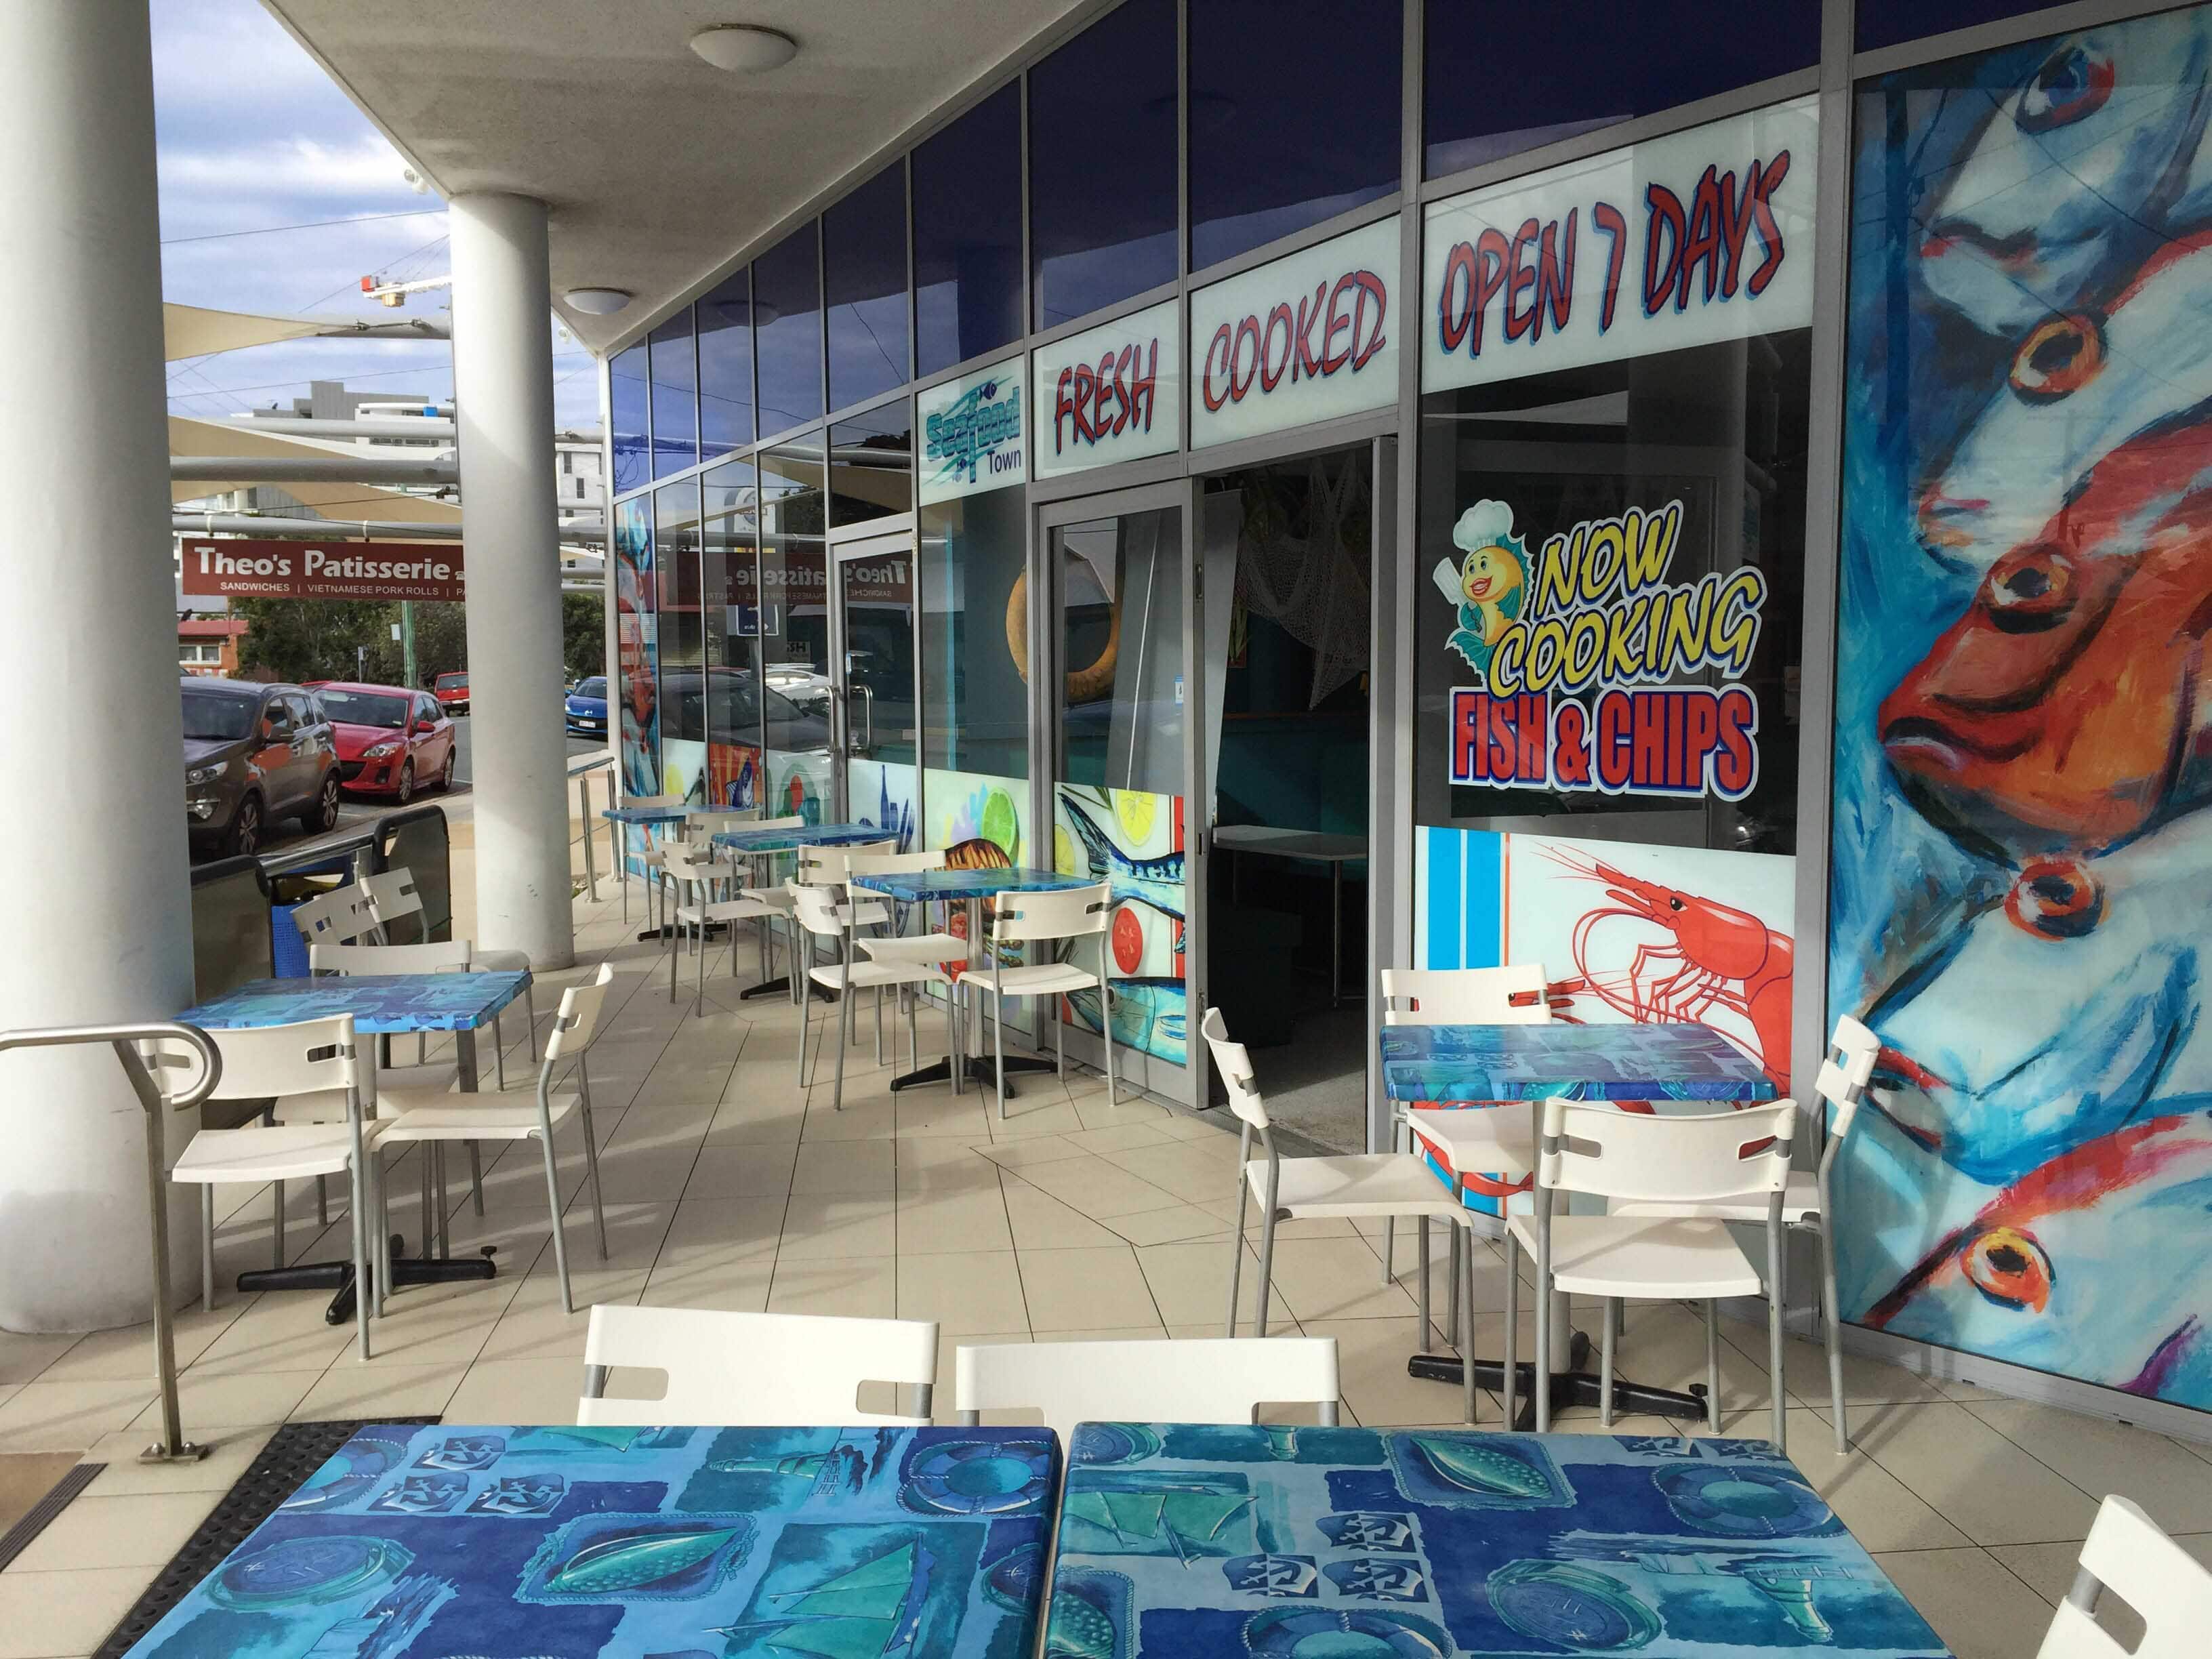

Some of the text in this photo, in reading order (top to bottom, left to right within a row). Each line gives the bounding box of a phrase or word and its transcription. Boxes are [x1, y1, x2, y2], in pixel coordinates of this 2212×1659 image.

[1438, 149, 1792, 359] OPEN 7 DAYS
[1054, 269, 1387, 457] FRESH COOKED
[926, 386, 1020, 483] Seafood
[987, 449, 1021, 475] Town
[194, 547, 450, 580] Theo's Patisserie
[220, 581, 290, 592] SANDWICHES
[308, 584, 373, 594] VIETNAMESE
[375, 586, 404, 594] PORK
[407, 586, 438, 596] ROLLS
[1532, 501, 1682, 622] NOW
[1487, 571, 1763, 701] COOKING
[1452, 689, 1755, 795] FISH & CHIPS
